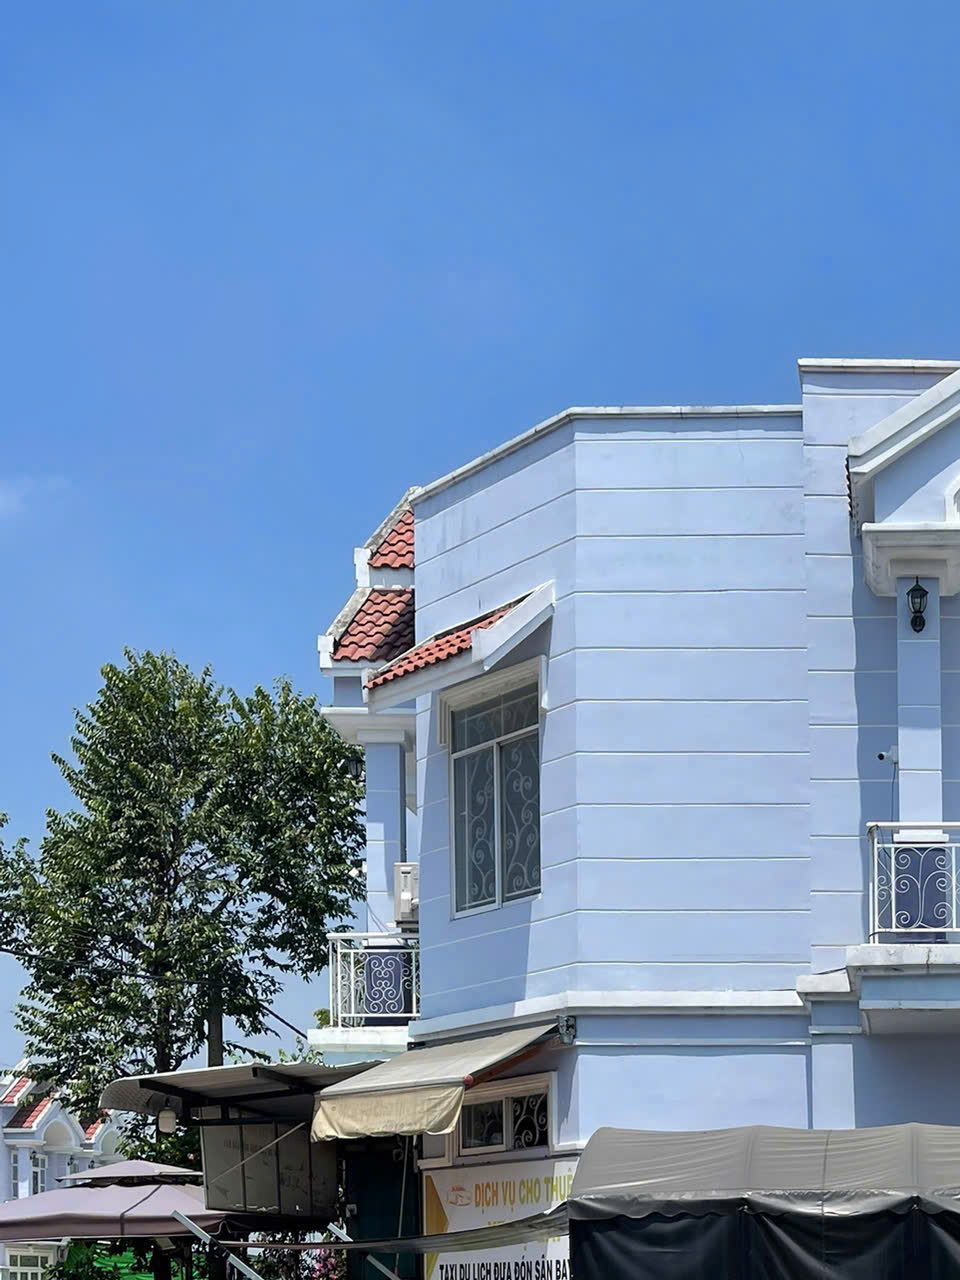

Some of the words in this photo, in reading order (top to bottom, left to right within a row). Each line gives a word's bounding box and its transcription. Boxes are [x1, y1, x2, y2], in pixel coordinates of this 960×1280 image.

[474, 1181, 499, 1215] DỊCH
[502, 1179, 516, 1213] VỤ
[518, 1177, 541, 1205] CHO
